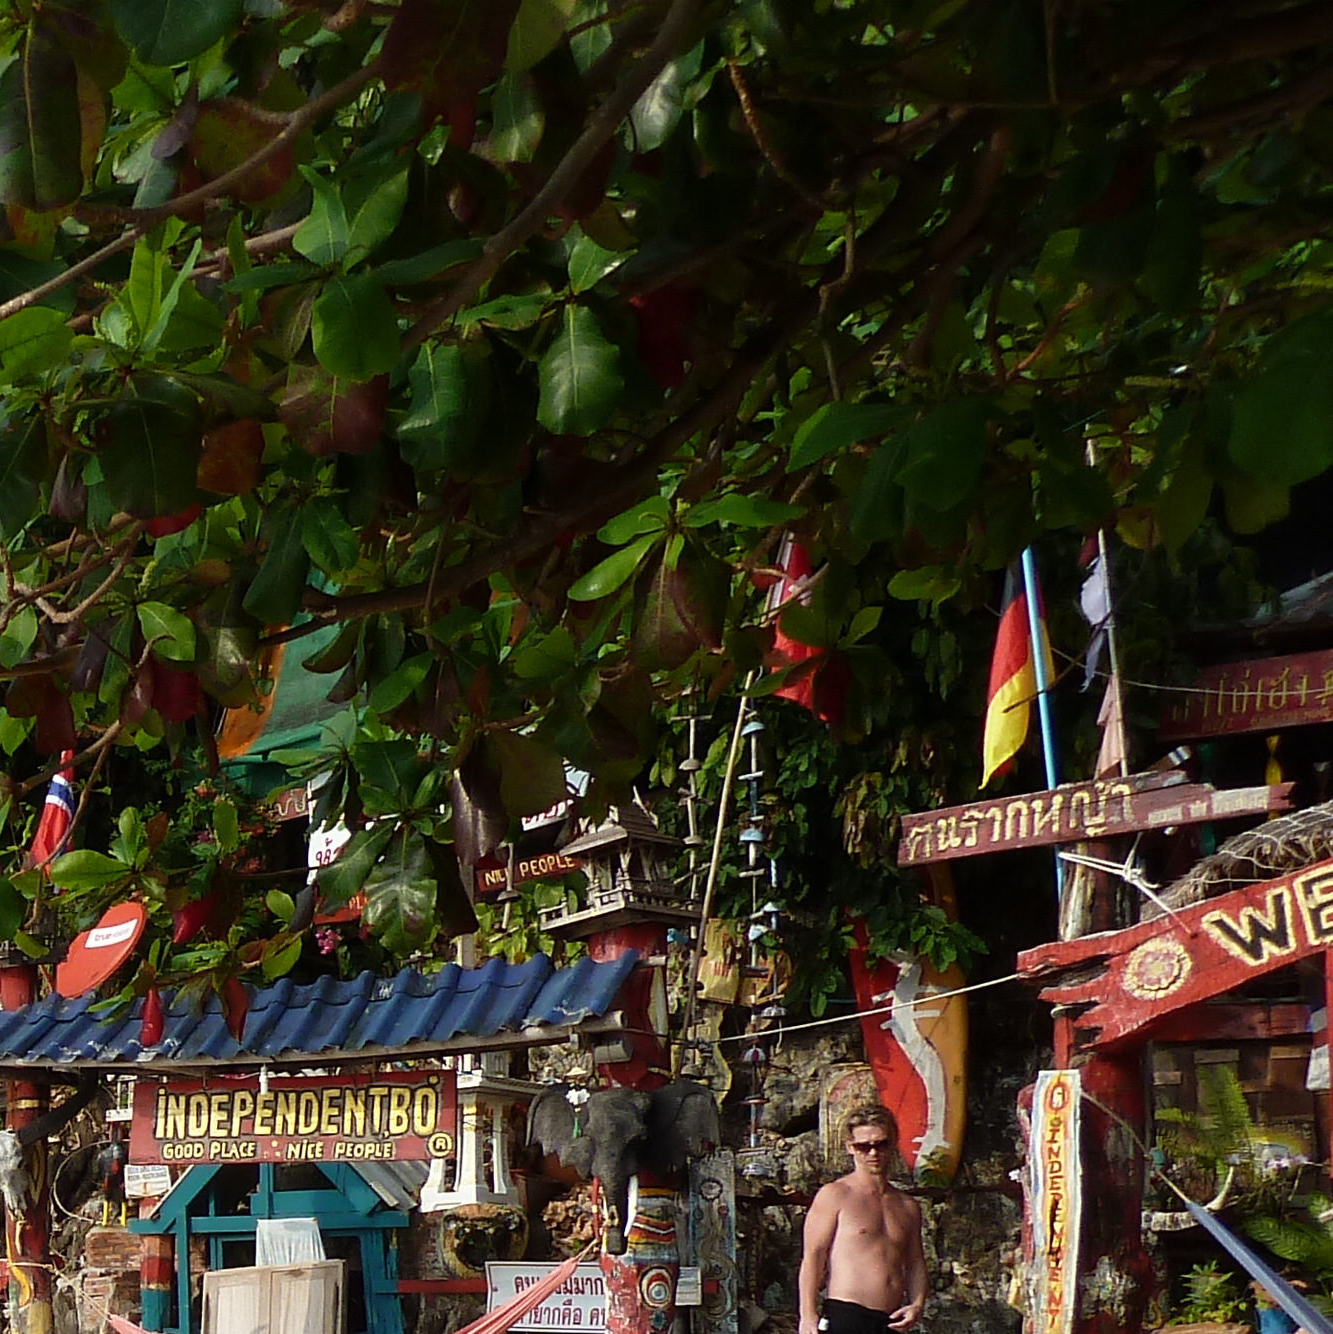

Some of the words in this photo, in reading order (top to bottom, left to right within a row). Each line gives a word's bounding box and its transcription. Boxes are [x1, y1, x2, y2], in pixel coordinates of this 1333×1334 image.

[485, 867, 509, 886] NIC
[519, 855, 575, 878] PEOPLE
[162, 1141, 204, 1160] GOOD
[209, 1141, 257, 1159] PLACE
[334, 1141, 393, 1159] PEOPLE
